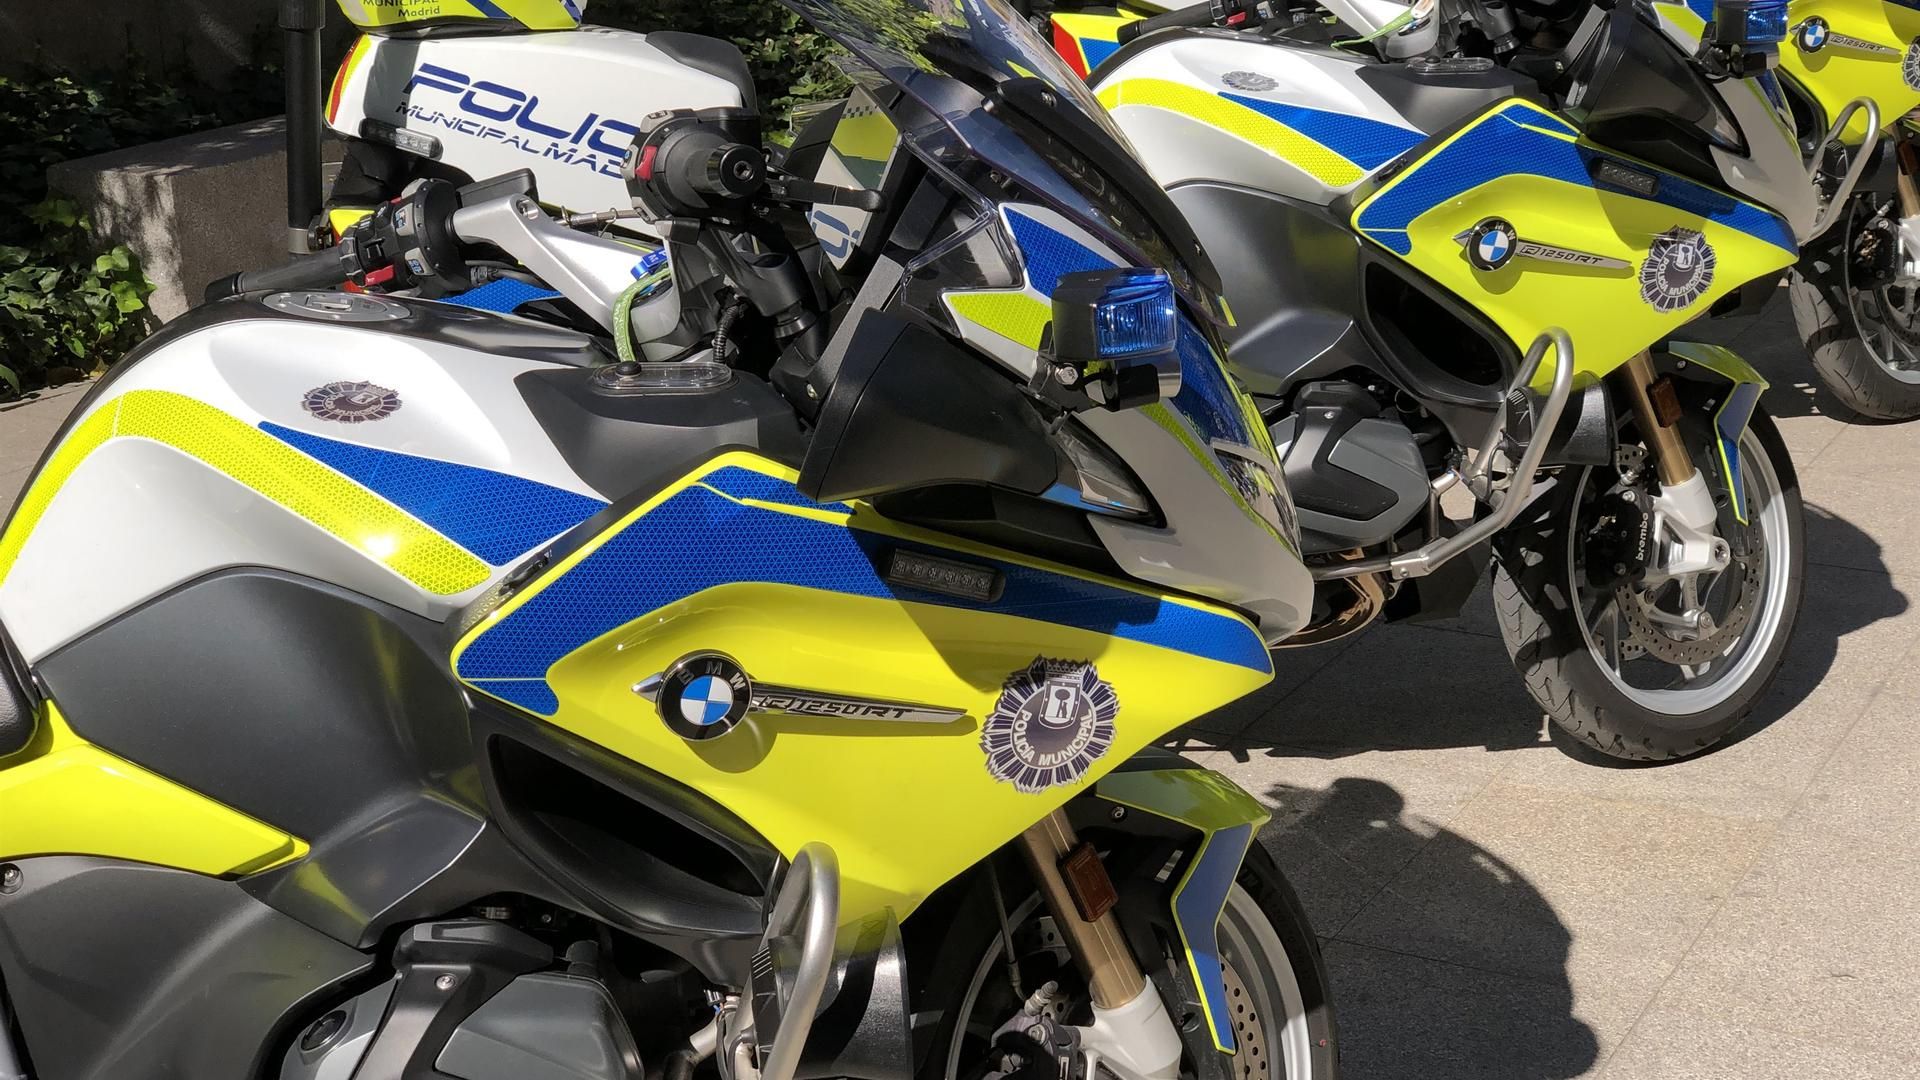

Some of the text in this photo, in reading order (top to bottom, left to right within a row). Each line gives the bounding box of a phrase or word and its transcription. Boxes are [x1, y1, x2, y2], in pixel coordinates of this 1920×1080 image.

[398, 6, 440, 17] Madrid
[395, 101, 541, 154] MUNICIPAL
[1668, 264, 1702, 295] MUNICIPAL
[1635, 512, 1649, 560] brembo
[1013, 708, 1093, 767] POLICÍA MUNICIPAL
